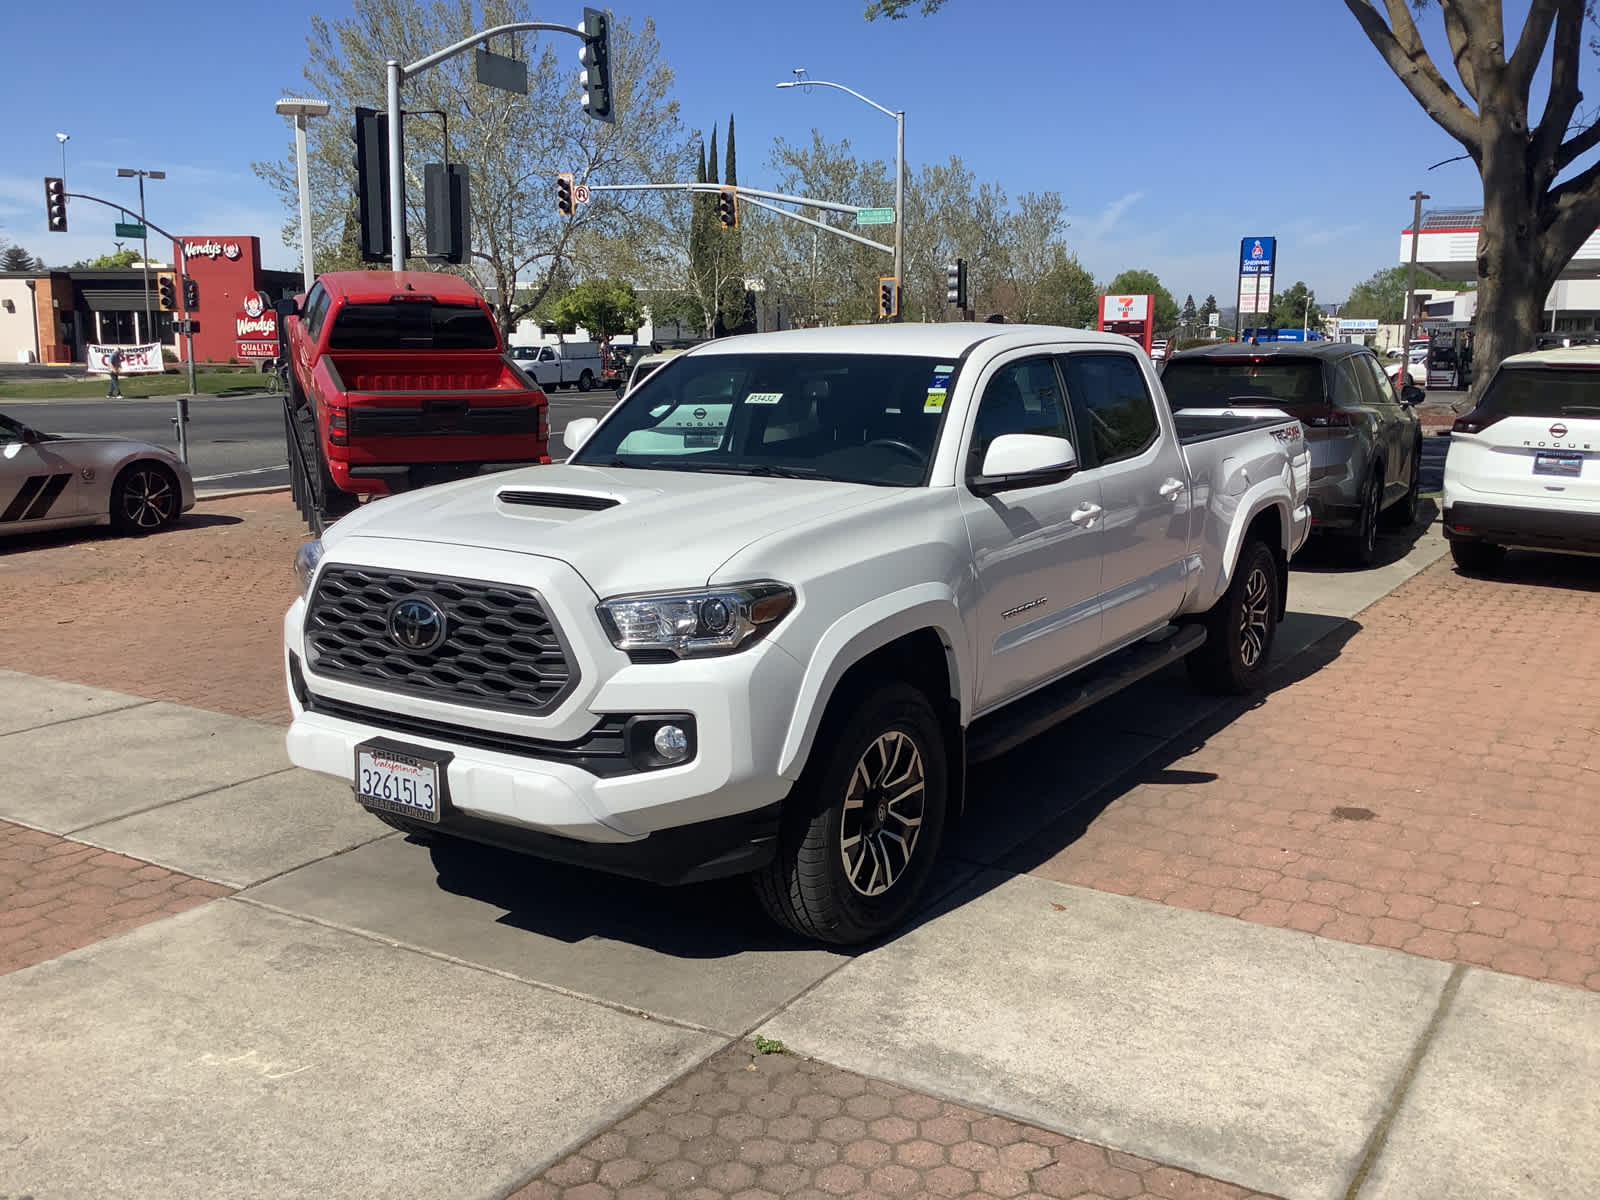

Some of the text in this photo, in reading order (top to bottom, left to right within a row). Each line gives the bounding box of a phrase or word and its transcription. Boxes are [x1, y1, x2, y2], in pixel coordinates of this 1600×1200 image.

[1243, 265, 1270, 273] WILLIMS
[236, 315, 275, 337] Wendy's
[241, 343, 274, 351] QUALITY
[1523, 440, 1591, 449] ROGUE
[363, 768, 434, 810] 32615L3
